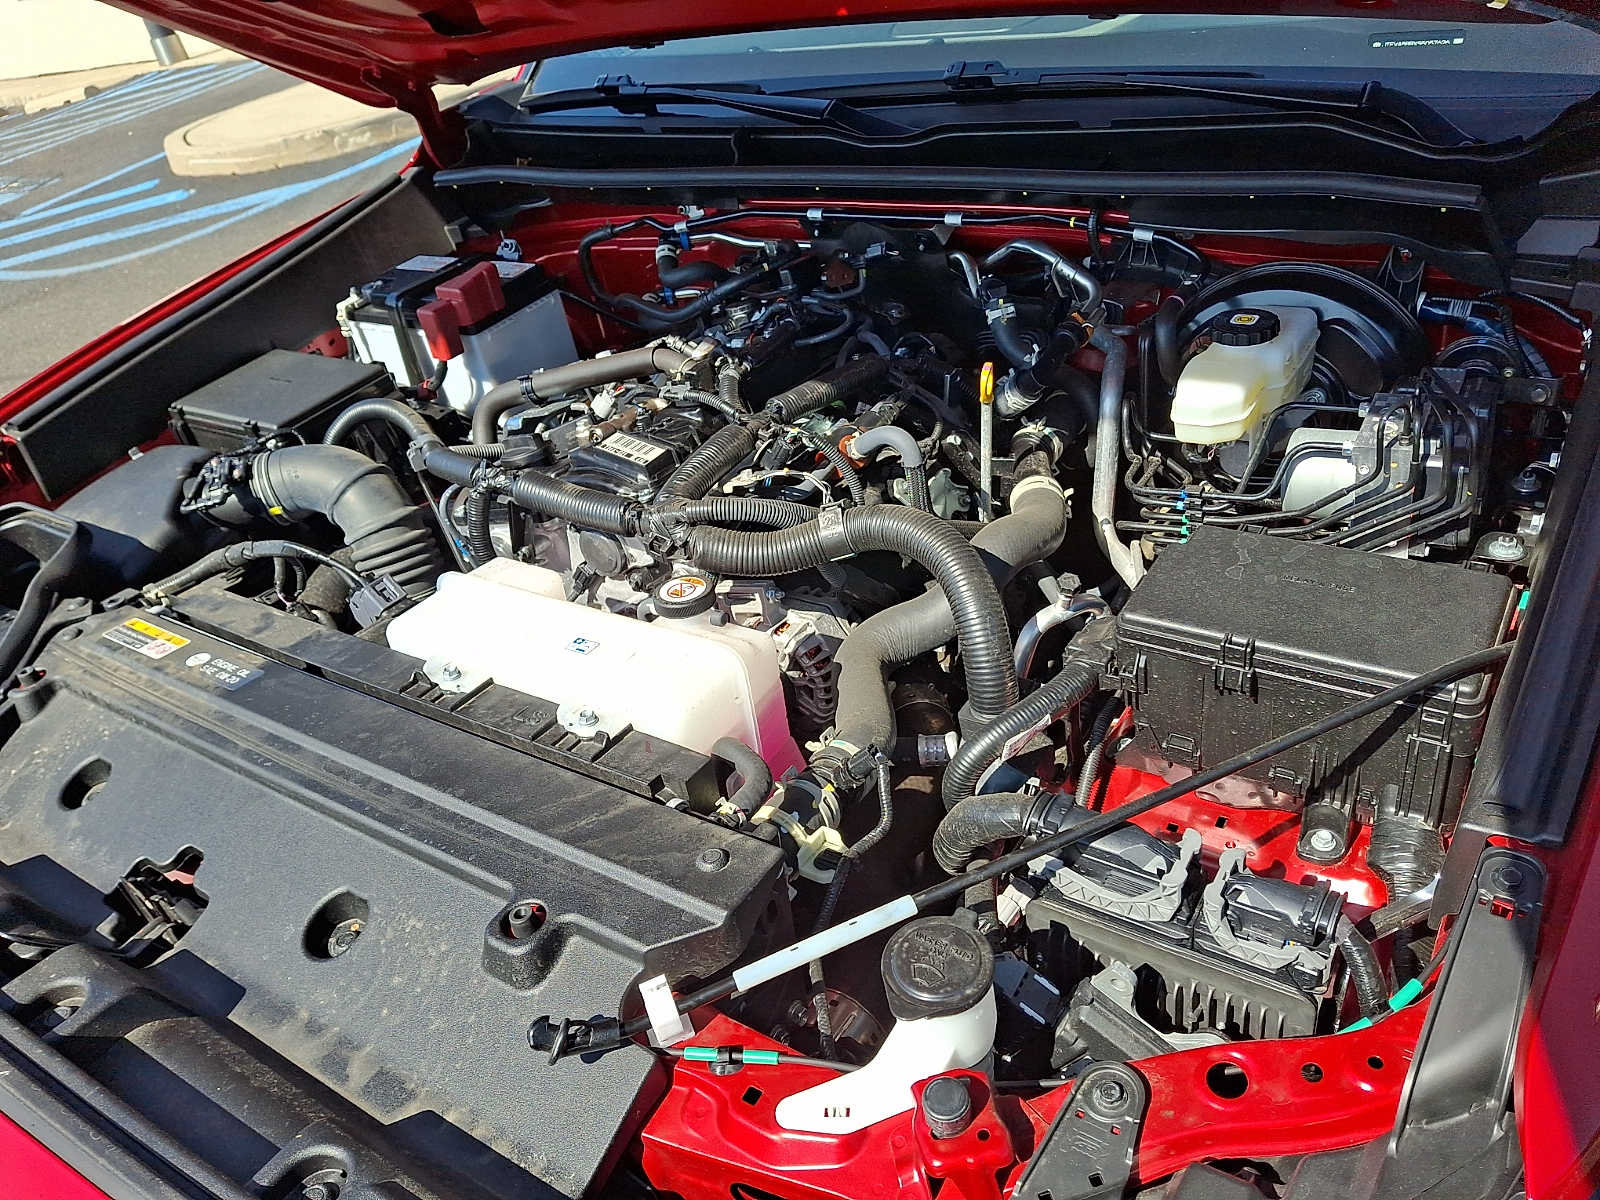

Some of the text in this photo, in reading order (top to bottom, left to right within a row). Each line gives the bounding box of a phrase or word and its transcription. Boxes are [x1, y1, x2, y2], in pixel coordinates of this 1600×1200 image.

[1328, 582, 1356, 594] FUSE
[914, 930, 974, 962] WASHER FLUID
